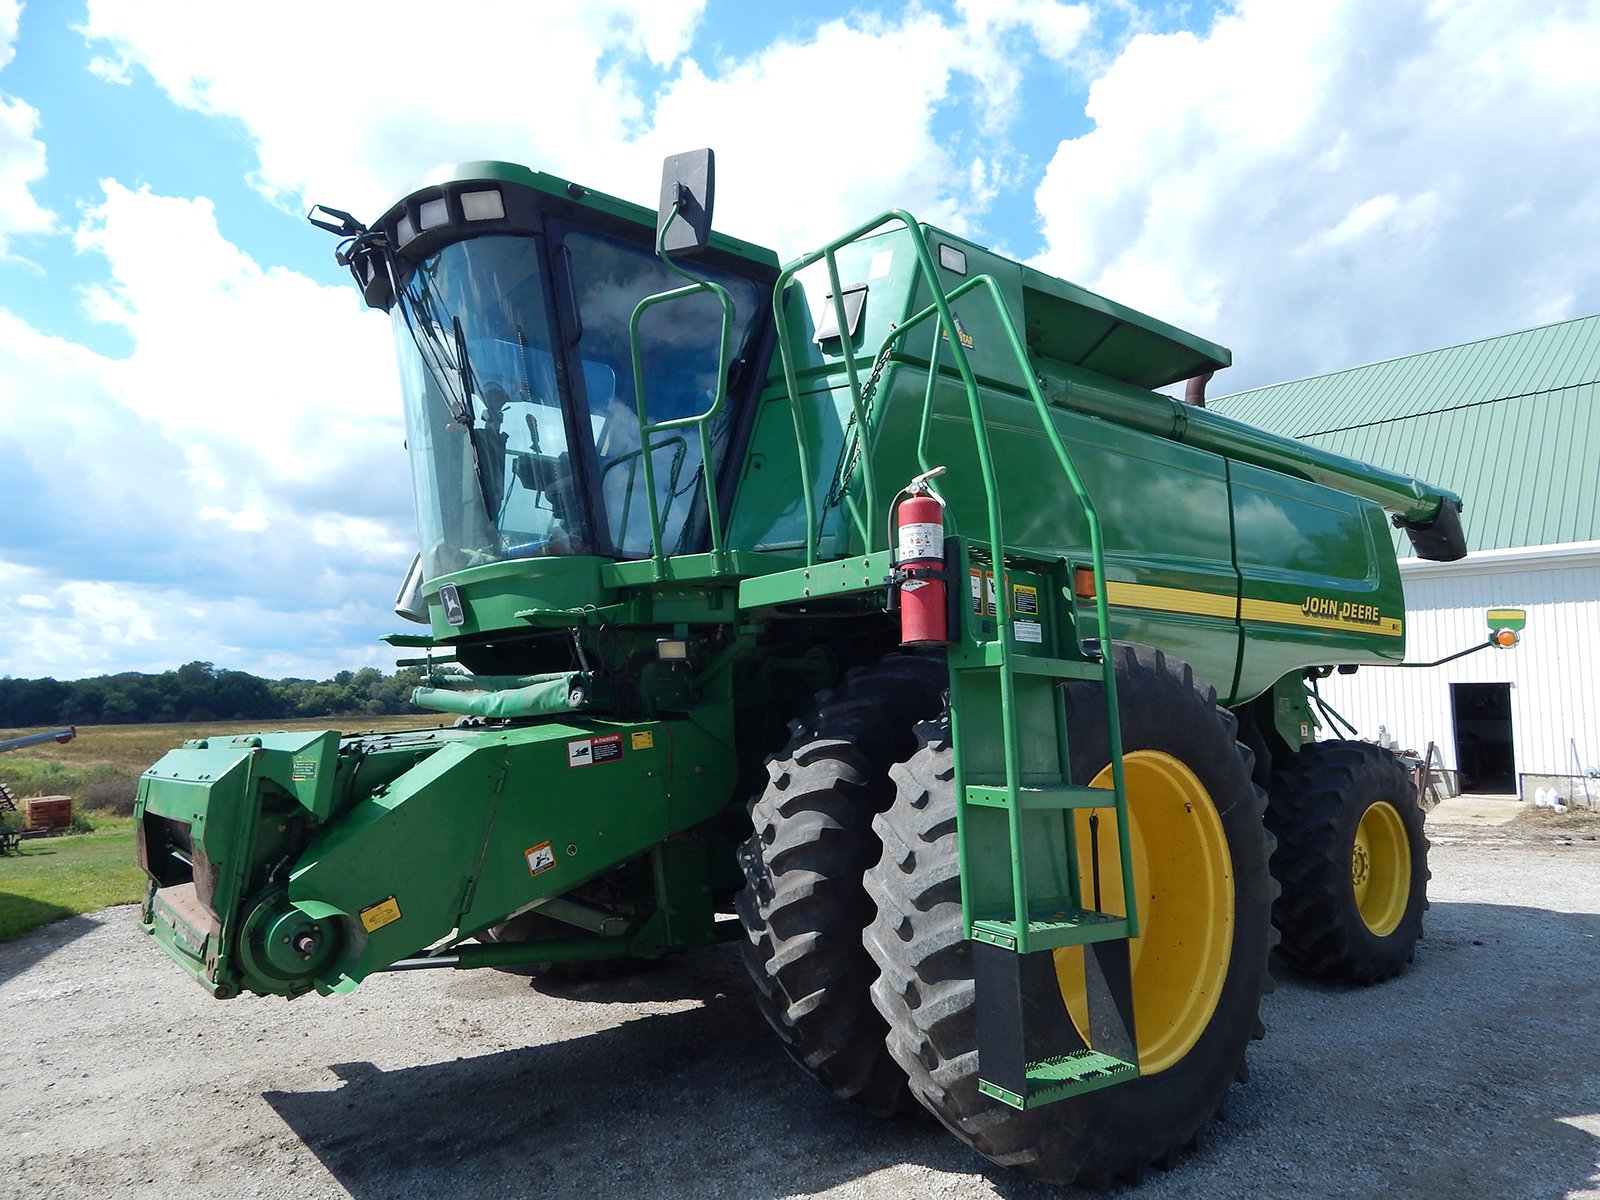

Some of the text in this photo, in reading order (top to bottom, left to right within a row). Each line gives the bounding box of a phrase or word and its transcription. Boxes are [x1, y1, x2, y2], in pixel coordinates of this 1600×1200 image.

[1301, 596, 1380, 622] JOHN DEERE
[598, 735, 619, 744] DANGER
